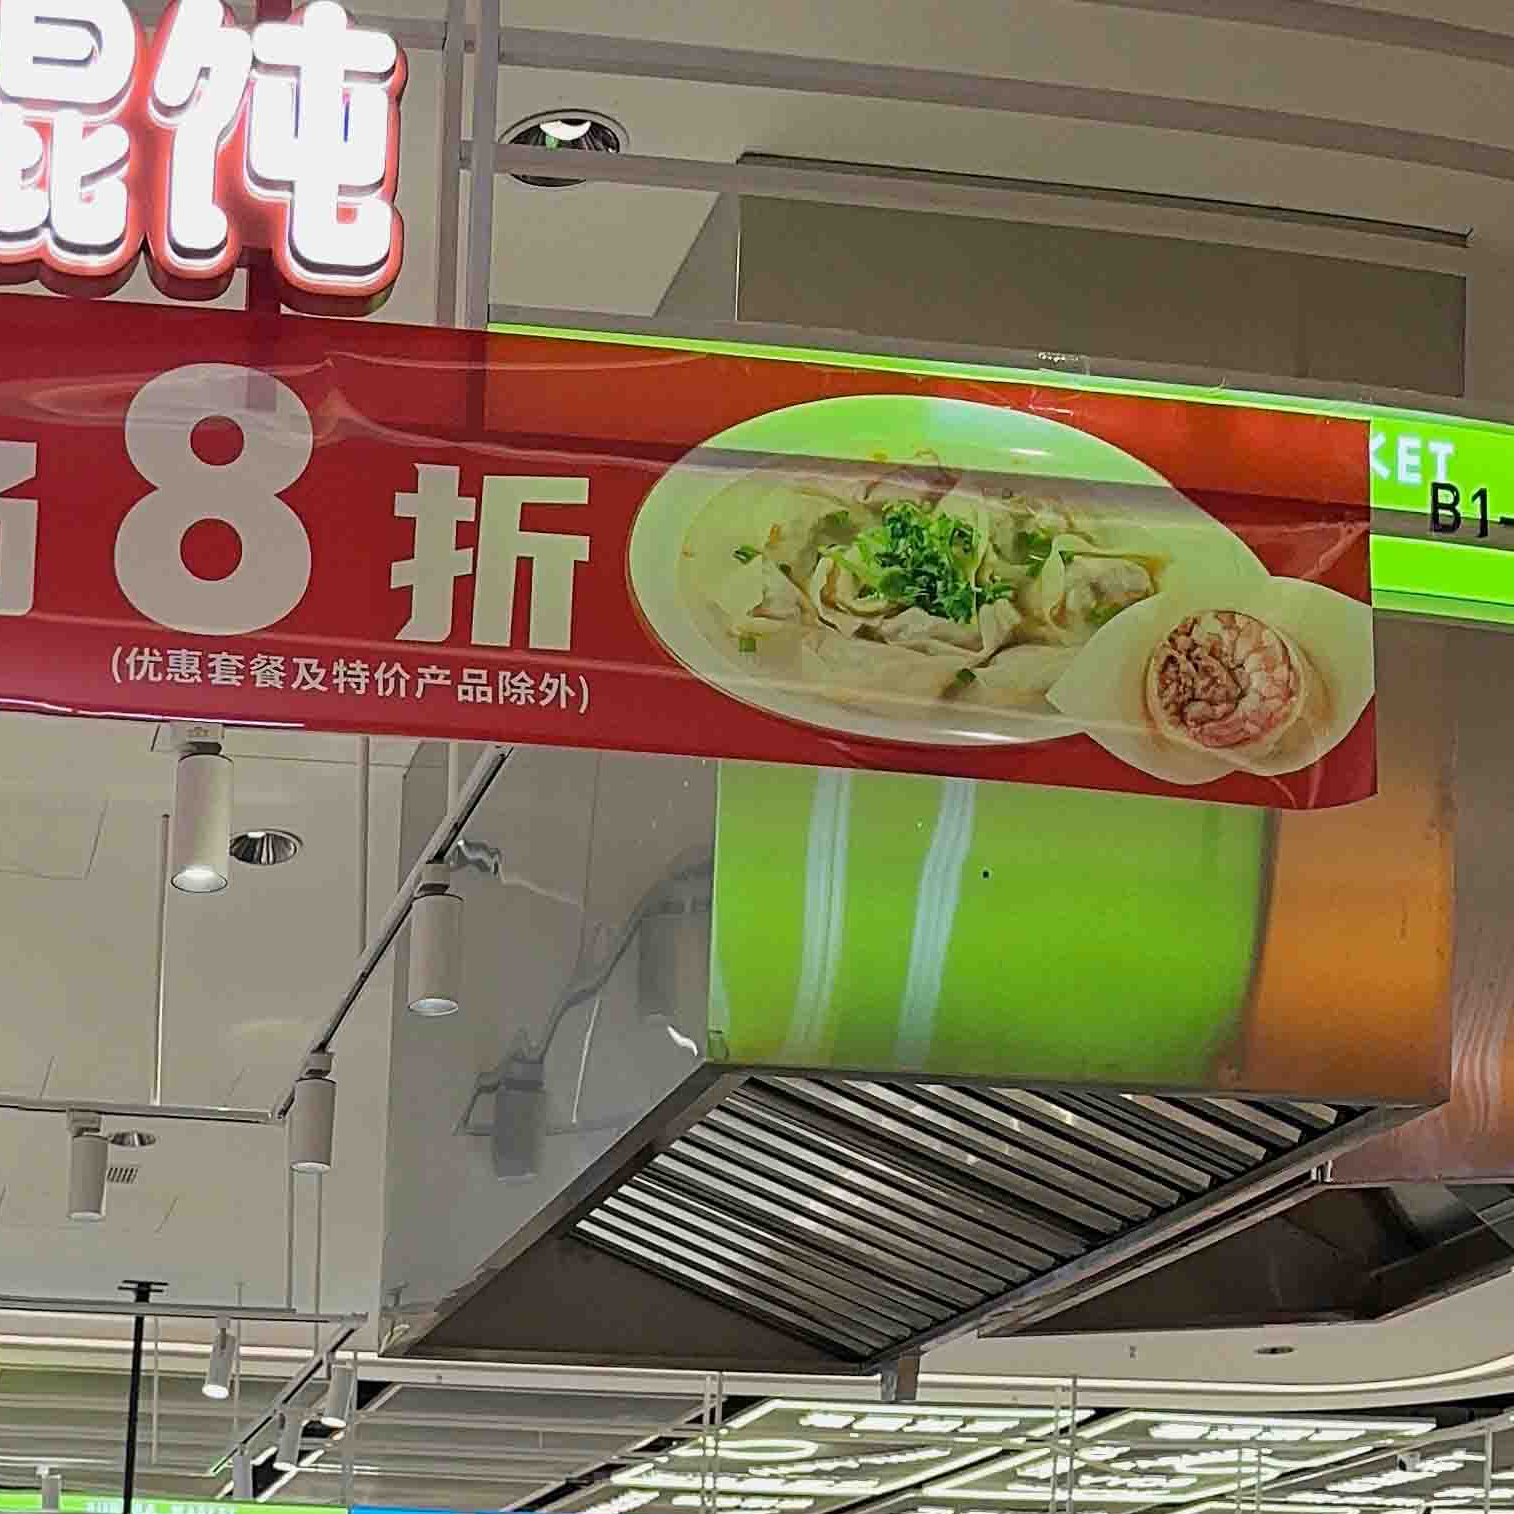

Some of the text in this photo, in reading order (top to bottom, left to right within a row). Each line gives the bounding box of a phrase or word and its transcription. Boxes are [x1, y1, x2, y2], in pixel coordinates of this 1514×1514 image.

[109, 645, 593, 712] (优惠套餐及特价产品除外)
